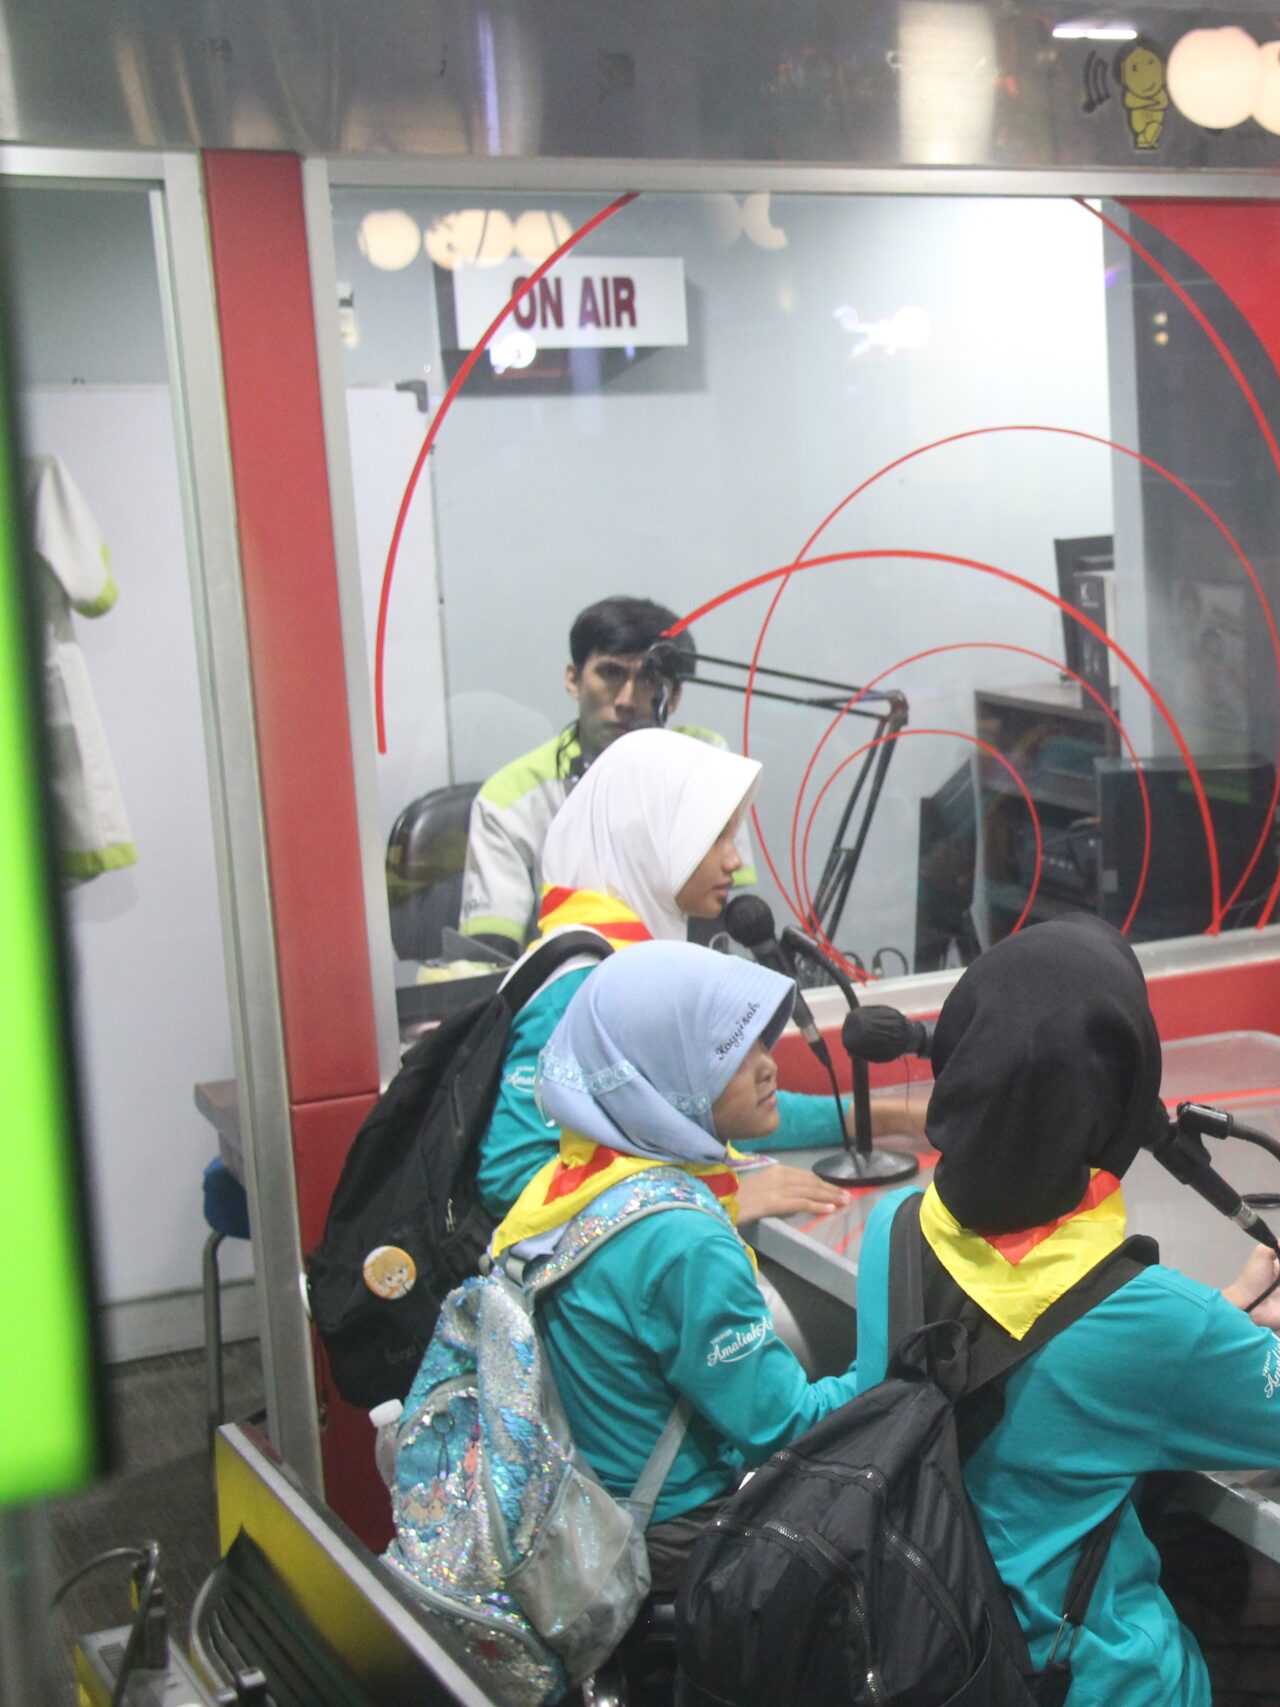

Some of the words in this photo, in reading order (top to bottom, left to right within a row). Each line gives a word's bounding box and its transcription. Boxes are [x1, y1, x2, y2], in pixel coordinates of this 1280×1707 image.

[511, 276, 564, 329] ON
[578, 276, 637, 328] AIR
[707, 1322, 762, 1367] Amaliah
